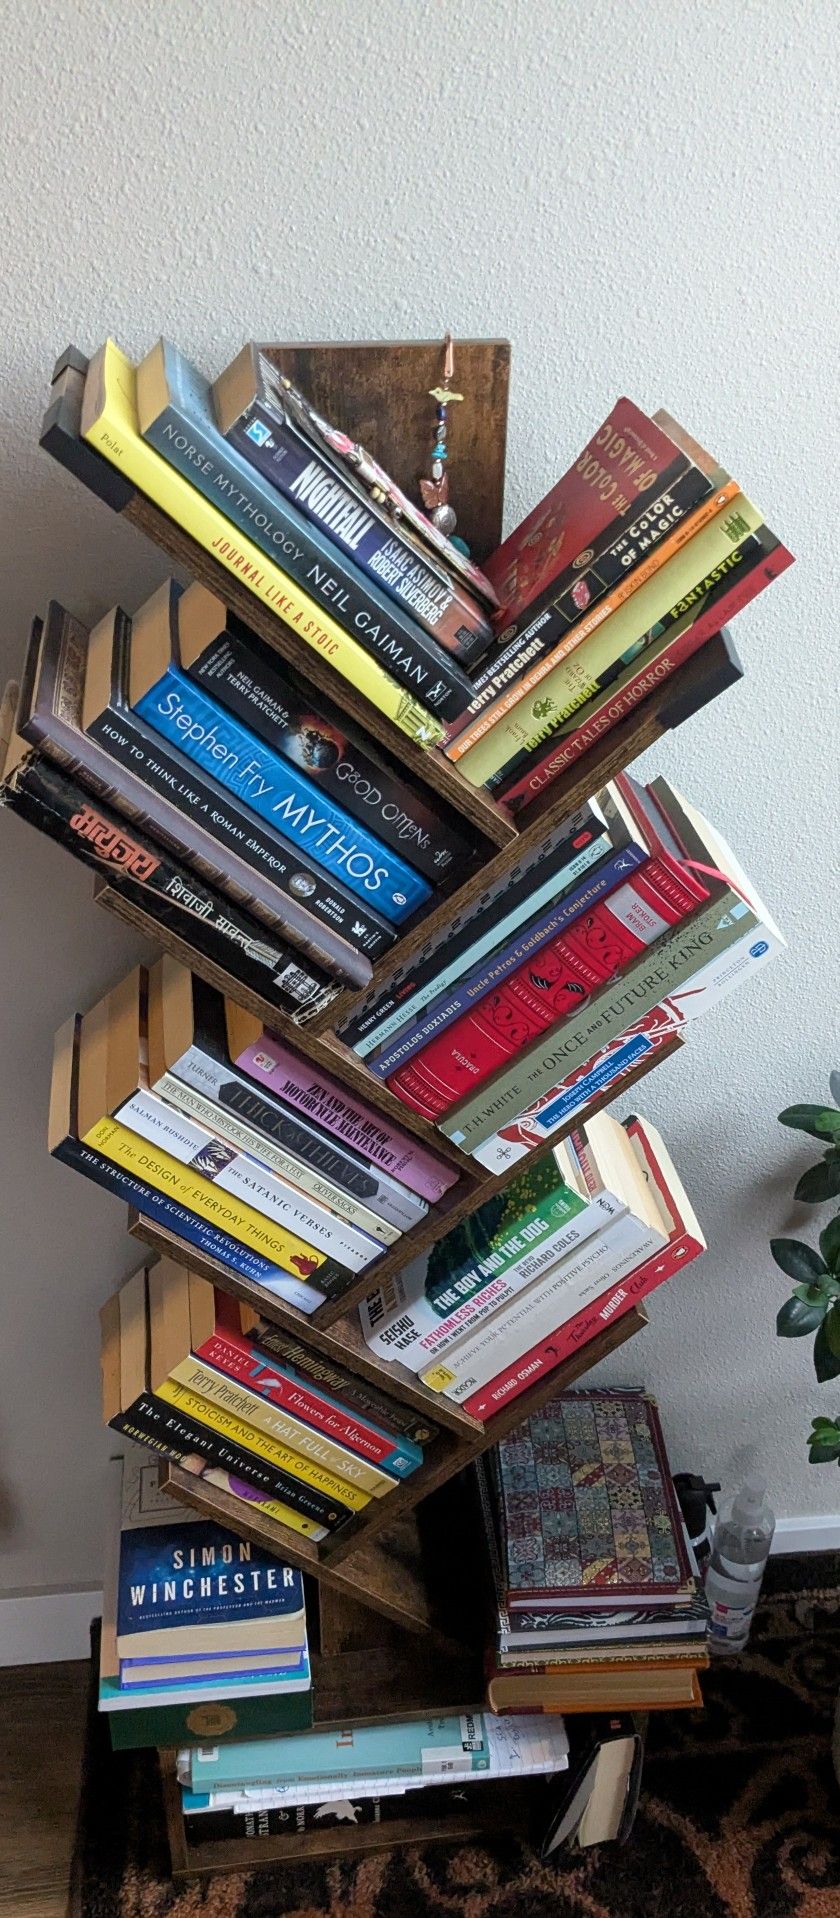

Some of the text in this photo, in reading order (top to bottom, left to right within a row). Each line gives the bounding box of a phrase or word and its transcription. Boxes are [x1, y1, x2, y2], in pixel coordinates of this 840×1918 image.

[100, 432, 124, 457] Polat
[595, 424, 644, 478] MAGIC
[162, 424, 304, 560] NORSE MYTHOLOGY
[289, 460, 376, 550] NIGHTFALL
[632, 468, 658, 492] OF
[610, 539, 628, 556] THE
[630, 494, 675, 538] COLOR
[621, 551, 638, 566] OF
[638, 505, 684, 550] MAGIC
[212, 537, 340, 656] JOURNAL LIKE A STOIC
[368, 551, 444, 626] ROBERT SILVERBERG
[380, 538, 453, 610] ISAAC ASIMOV &
[618, 559, 660, 600] RUSKIN BOND
[306, 564, 428, 684] NEIL GAIMAN
[458, 605, 613, 753] OUR TREES STILL GROW IN DEHRA AND OTHER STORIES
[493, 637, 546, 692] Pratchett
[226, 673, 289, 729] TERRY PRATCHETT
[530, 746, 576, 791] CLASSIC
[570, 716, 608, 752] TALES
[608, 702, 625, 720] OF
[625, 658, 676, 705] HORROR
[102, 724, 287, 874] HOW TO THINK LIKE A ROMAN EMPEROR
[157, 692, 388, 890] Stephen Fry MYTHOS
[165, 875, 214, 920] शिवाजी
[314, 899, 344, 924] ROBERTSON
[324, 897, 346, 915] DONALD
[625, 912, 646, 932] BRAM
[631, 902, 658, 928] STOKER
[379, 878, 608, 1071] APOSTOLOS DOXIADIS Uncle Petros & Goldbach's Conjecture
[366, 1022, 398, 1049] HERMANN
[396, 1004, 416, 1024] HESSE
[482, 1086, 522, 1118] WHITE
[528, 1069, 543, 1082] THE
[542, 1031, 589, 1072] ONCE
[587, 1020, 603, 1034] AND
[601, 968, 670, 1024] FUTURE
[668, 931, 714, 970] KING
[187, 1061, 219, 1086] TURNER
[450, 1049, 480, 1074] DRACULA
[562, 1060, 615, 1104] JOSEPH CAMPBELL
[96, 1126, 108, 1139] DON
[98, 1126, 120, 1147] NORMAN
[230, 1086, 289, 1138] THICK
[300, 1138, 369, 1193] THIEVES
[280, 1080, 398, 1166] MOTORCYCLE MAINTENANCE
[118, 1142, 286, 1254] The DESIGN of EVERYDAY THINGS
[128, 1103, 162, 1130] SALMAN
[162, 1124, 200, 1150] RUSHDIE
[228, 1166, 242, 1180] THE
[242, 1175, 290, 1212] SATANIC
[293, 1208, 334, 1239] VERSES
[80, 1150, 270, 1272] THE STRUCTURE OF SCIENTIFIC REVOLUTIONS
[432, 1287, 461, 1311] THE
[454, 1269, 482, 1296] BOY
[481, 1254, 502, 1278] AND
[498, 1236, 526, 1263] THE
[520, 1217, 550, 1244] DOG
[518, 1230, 580, 1279] RICHARD COLES
[612, 1239, 654, 1273] AWAKENINGS
[379, 1315, 416, 1346] SEISHU
[394, 1329, 422, 1352] HASE
[420, 1280, 508, 1350] FATHOMLESS RICHES
[208, 1350, 242, 1374] KEYES
[213, 1342, 250, 1369] DANIEL
[262, 1334, 350, 1391] Ernest Hemingway
[492, 1358, 544, 1401] RICHARD OSMAN
[185, 1397, 358, 1502] STOICISM AND THE ART OF HAPPINESS
[288, 1391, 383, 1456] Flowers for Algernon
[136, 1402, 326, 1515] The Elegant Universe Brian Greene
[172, 1541, 252, 1570] SIMON
[130, 1566, 296, 1606] WINCHESTER
